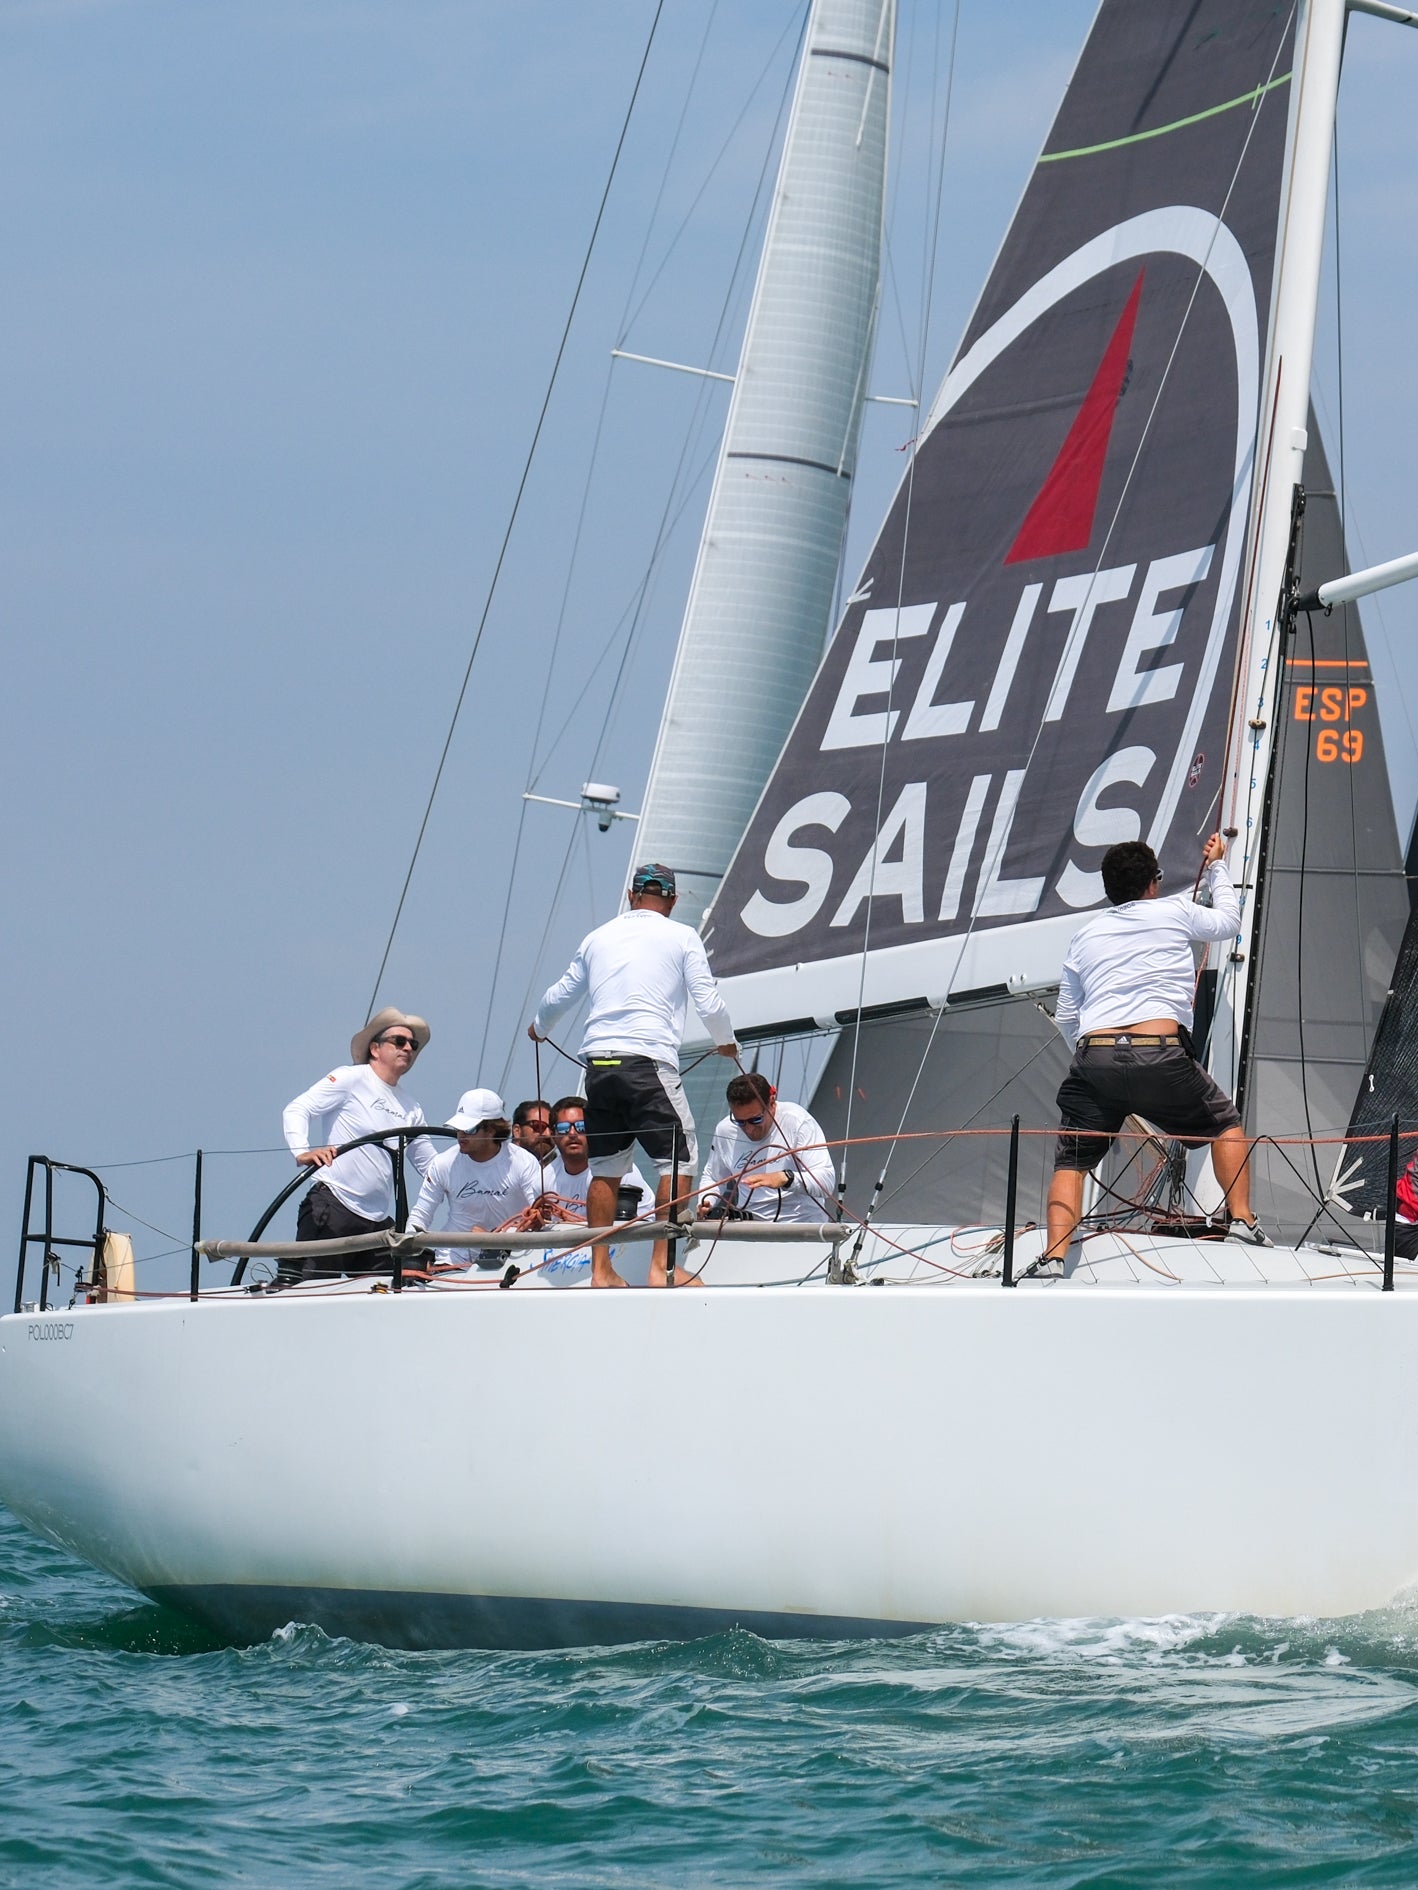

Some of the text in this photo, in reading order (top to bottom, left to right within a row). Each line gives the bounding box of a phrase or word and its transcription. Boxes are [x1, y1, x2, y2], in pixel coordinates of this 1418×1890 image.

[819, 543, 1216, 751] ELITE
[1261, 658, 1268, 669] 2
[1294, 687, 1367, 722] ESP
[1316, 728, 1364, 763] 69
[740, 746, 1157, 937] SAILS
